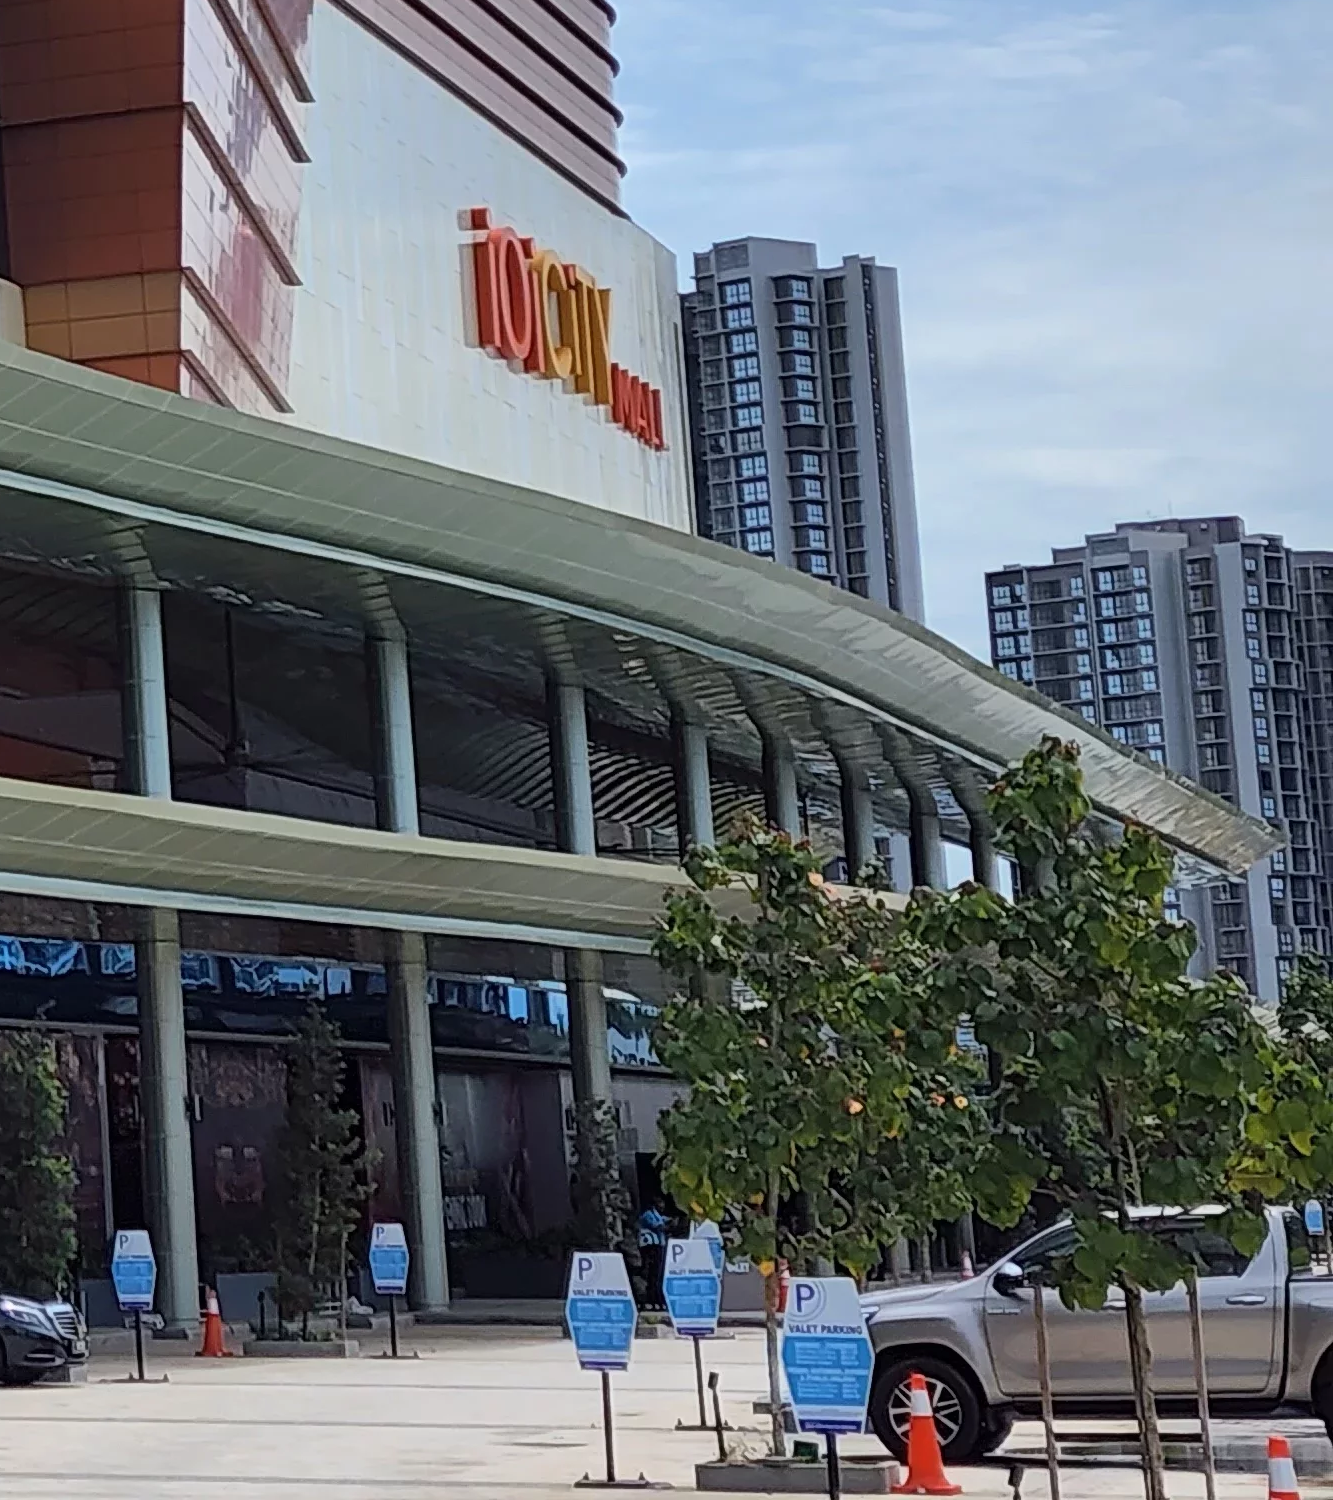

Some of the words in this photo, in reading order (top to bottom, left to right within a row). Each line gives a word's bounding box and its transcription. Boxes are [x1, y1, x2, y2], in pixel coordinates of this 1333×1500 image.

[611, 362, 663, 451] MALL
[578, 1257, 593, 1281] P
[796, 1283, 815, 1313] P
[788, 1323, 818, 1334] VALET
[820, 1324, 862, 1335] PARKING
